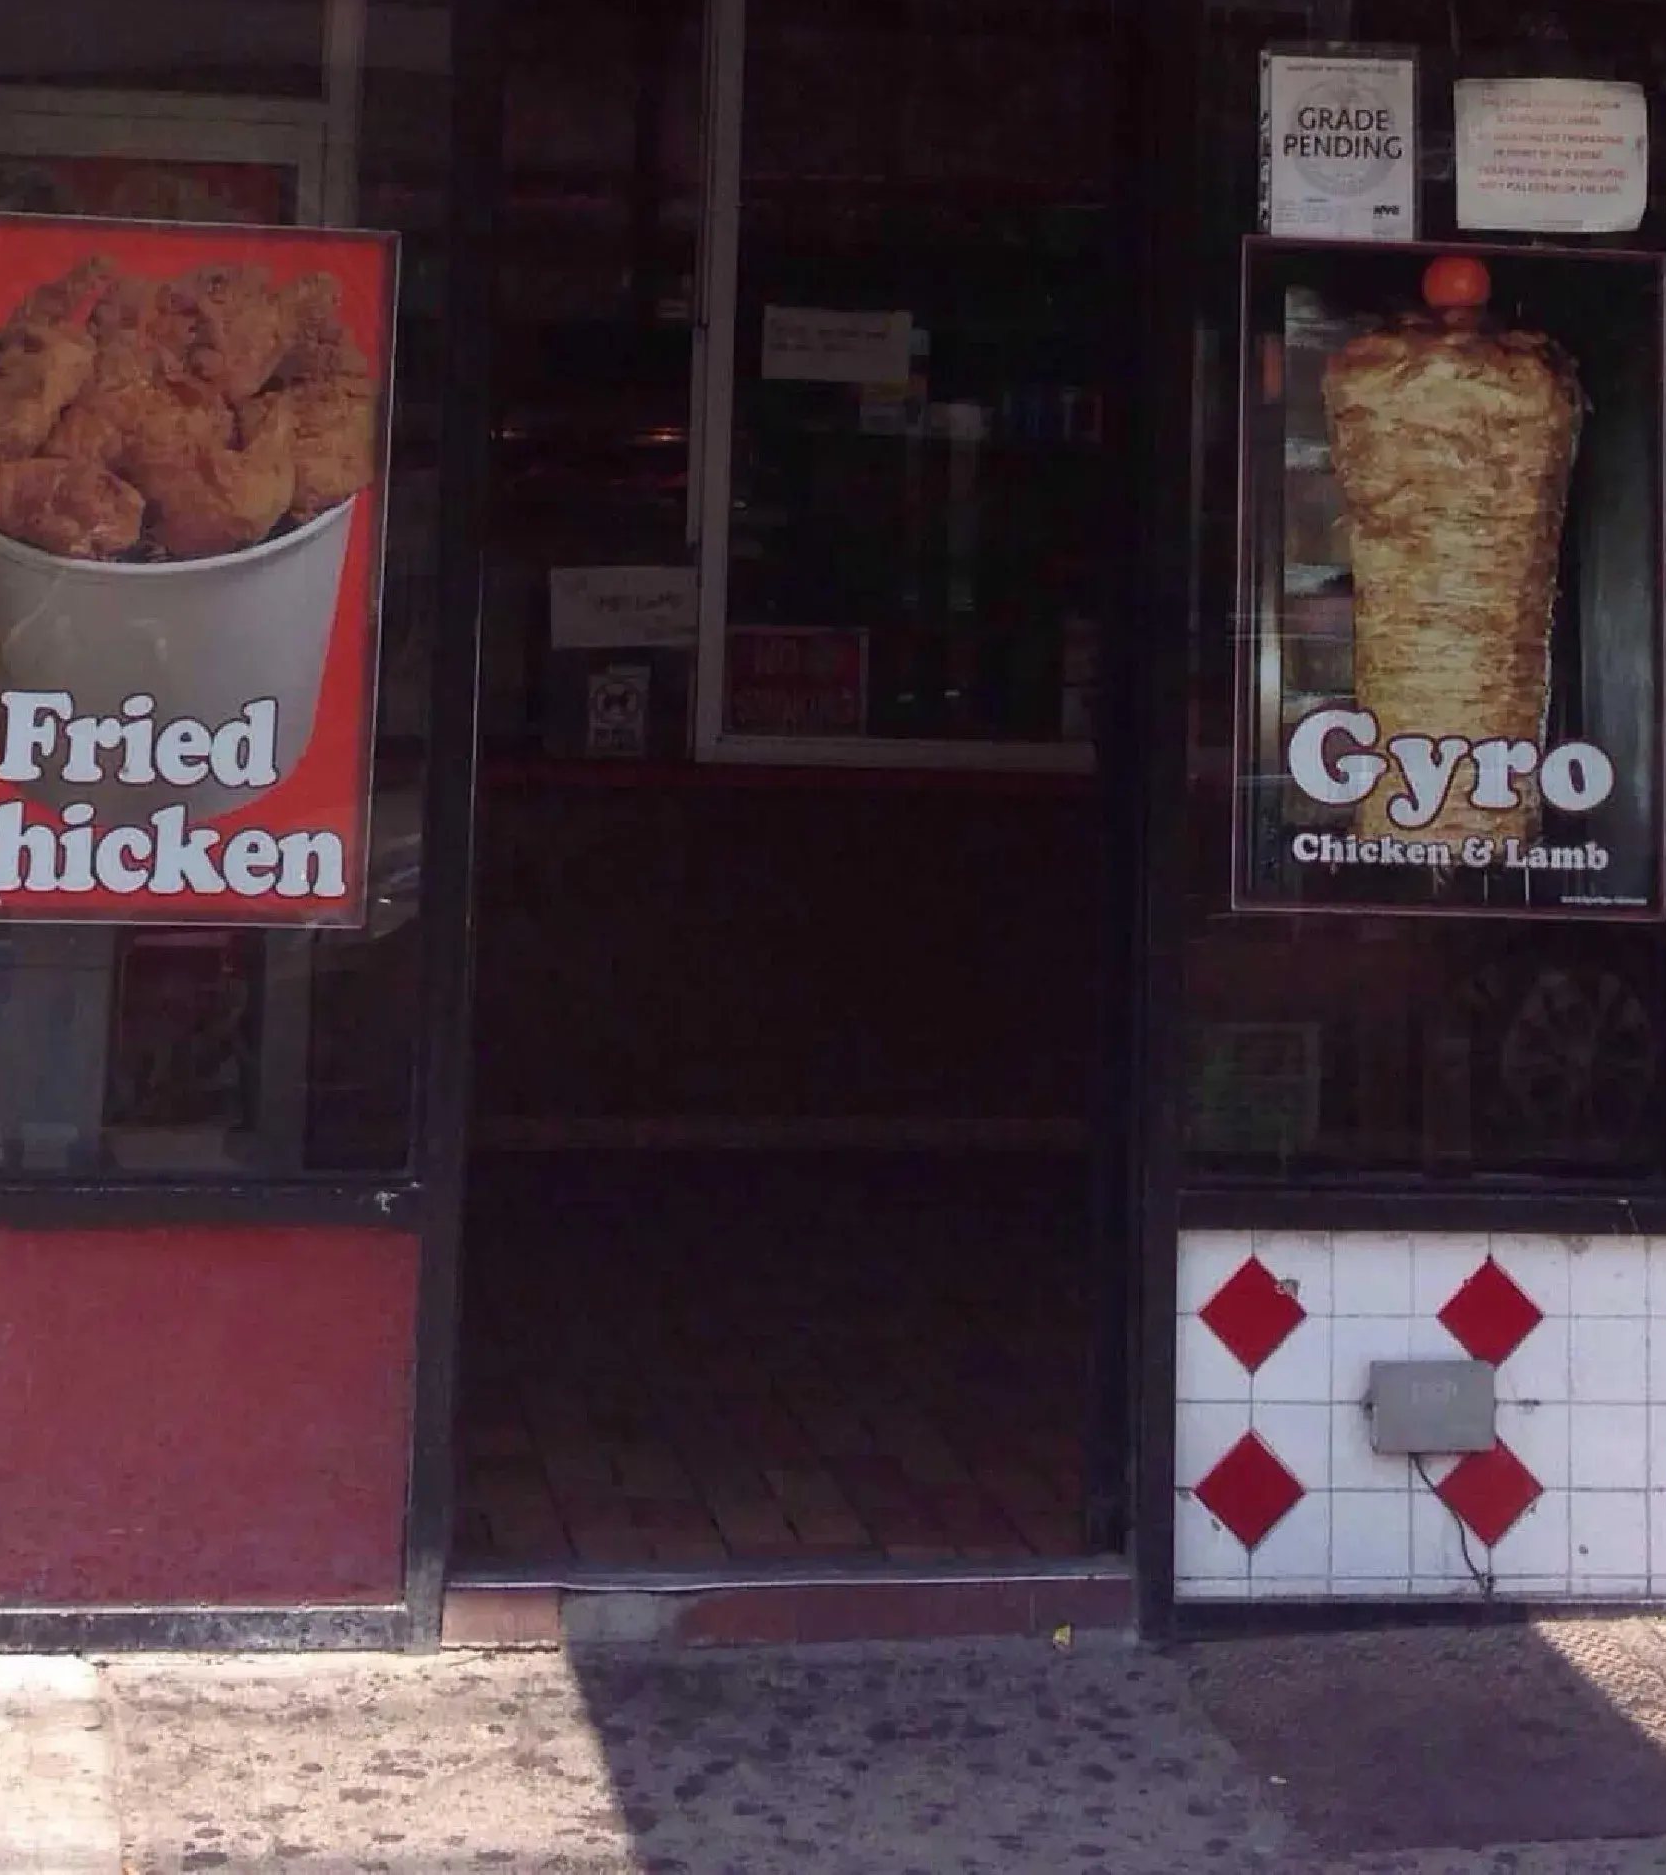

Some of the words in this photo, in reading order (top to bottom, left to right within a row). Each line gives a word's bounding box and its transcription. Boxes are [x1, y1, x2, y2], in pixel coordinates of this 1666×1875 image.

[1298, 106, 1390, 132] GRADE
[1283, 133, 1403, 160] PENDING
[1287, 709, 1615, 827] Gyro
[1292, 832, 1450, 866] Chicken
[1461, 835, 1493, 868] &
[1505, 838, 1609, 872] Lamb
